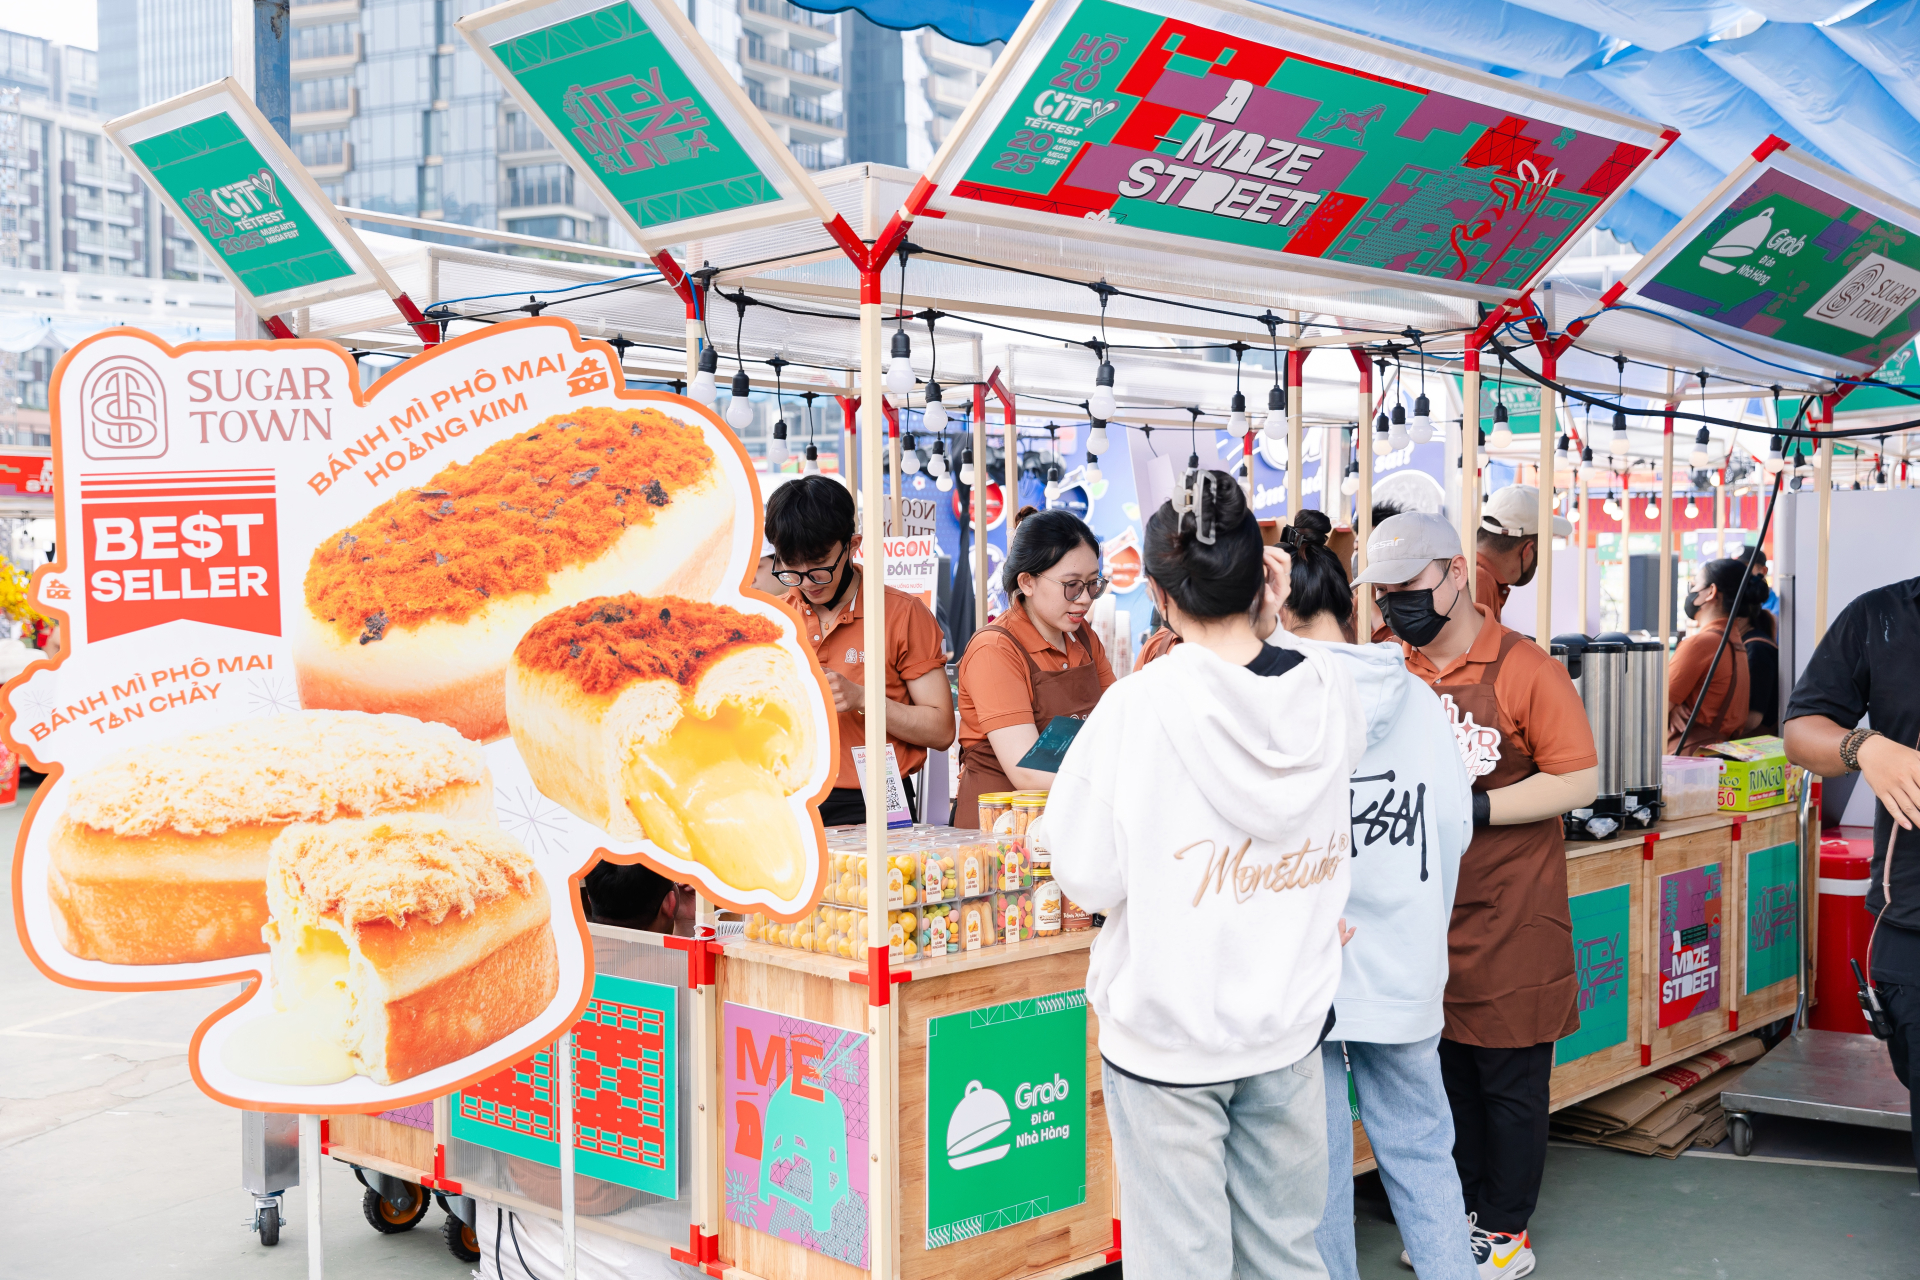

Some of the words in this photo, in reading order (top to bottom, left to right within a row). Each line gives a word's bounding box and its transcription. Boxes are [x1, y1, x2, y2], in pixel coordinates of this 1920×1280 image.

[1047, 151, 1069, 161] MEGA
[1052, 144, 1073, 154] ARTS
[1057, 137, 1081, 148] MUSIC
[1041, 157, 1061, 167] FEST
[260, 225, 282, 237] MUSIC
[280, 221, 297, 232] ARTS
[265, 233, 284, 244] MEGA
[282, 229, 300, 240] FEST
[1766, 228, 1808, 257] Grab
[219, 231, 267, 256] 2025
[1871, 278, 1917, 307] SUGAR
[1850, 298, 1897, 326] TOWN
[187, 367, 334, 403] SUGAR
[469, 392, 528, 428] KIM
[189, 408, 333, 444] TOWN
[307, 425, 391, 497] BÁNH
[389, 397, 430, 435] MÌ
[430, 368, 497, 412] PHÔ
[501, 353, 566, 385] MAI
[887, 561, 912, 576] ĐÓN
[914, 558, 935, 575] TẾT
[91, 566, 269, 603] SELLER
[29, 690, 109, 742] BÁNH
[111, 672, 147, 701] MÌ
[151, 657, 211, 688] PHÔ
[217, 654, 273, 674] MAI
[148, 681, 222, 713] CHẢY
[1749, 765, 1783, 792] RINGO
[1663, 965, 1718, 1004] STREET
[736, 1026, 825, 1103] MÊ
[1015, 1072, 1069, 1110] Grab
[1030, 1112, 1041, 1126] Đi
[1042, 1109, 1055, 1123] ăn
[1016, 1130, 1039, 1148] Nhà
[1040, 1124, 1070, 1142] Hàng
